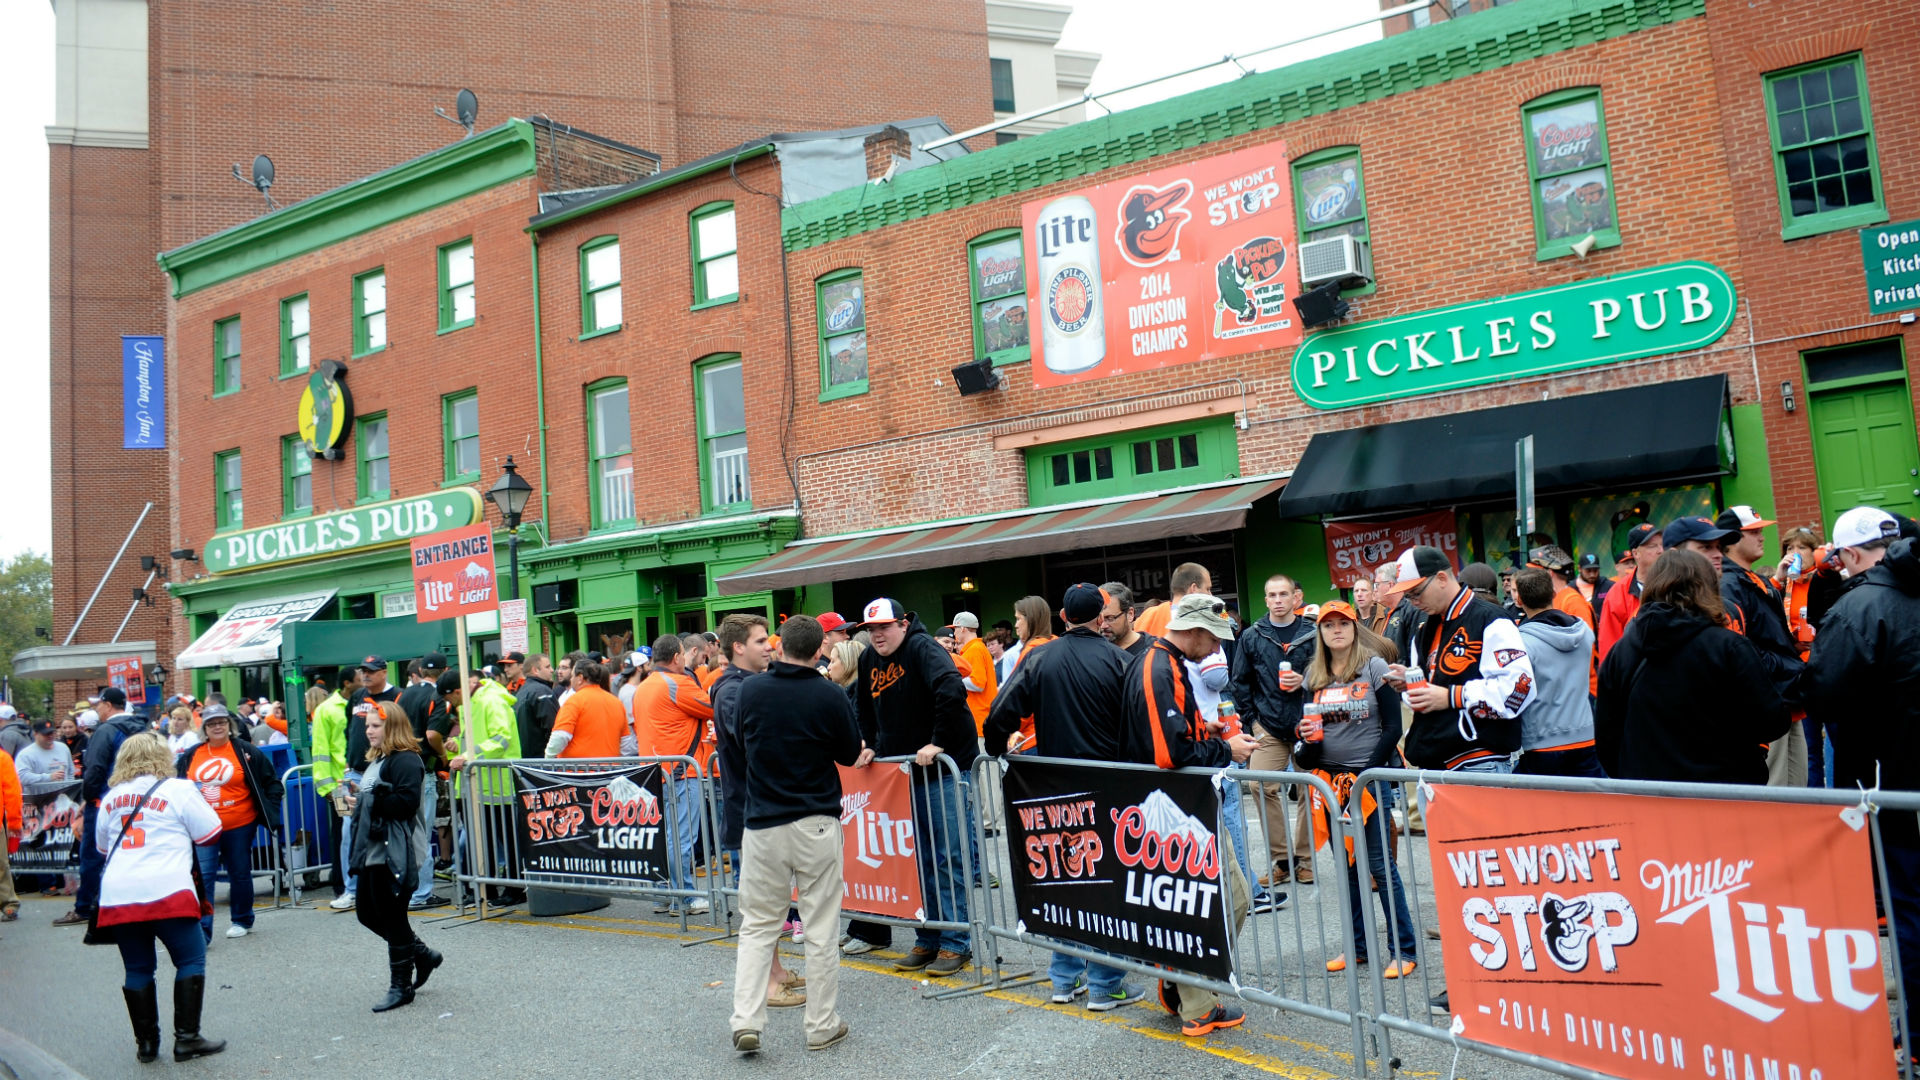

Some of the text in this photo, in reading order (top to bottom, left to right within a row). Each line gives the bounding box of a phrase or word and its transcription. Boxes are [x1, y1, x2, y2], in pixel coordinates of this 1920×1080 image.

[1540, 122, 1594, 147] Coors
[1543, 140, 1591, 160] LIGHT
[1204, 167, 1275, 202] WE WON'T
[1208, 182, 1280, 226] STOP
[1315, 191, 1344, 219] Lite
[1040, 215, 1091, 257] Lite
[1877, 229, 1919, 250] Open
[980, 256, 1019, 277] Coors
[984, 271, 1017, 288] LIGHT
[1063, 269, 1092, 303] PILSNER
[1140, 272, 1171, 299] 2014
[833, 305, 853, 329] Lite
[1058, 317, 1089, 331] BEER
[1128, 297, 1188, 329] DIVISION
[1132, 324, 1189, 357] CHAMPS
[1308, 282, 1714, 389] PICKLES PUB
[133, 341, 155, 444] Hampton Inn
[227, 499, 438, 566] PICKLES PUB
[1332, 525, 1427, 549] WE WON'T Miller
[415, 536, 489, 567] ENTRANCE
[1335, 540, 1394, 569] STOP
[422, 580, 455, 611] Lite
[459, 587, 491, 605] LIGHT
[1121, 566, 1164, 596] Lite
[229, 597, 327, 620] SPORTS RADIO
[522, 787, 579, 810] WE WON'T
[587, 787, 663, 827] Coors
[43, 801, 76, 830] Coor
[121, 811, 146, 850] 5
[527, 805, 585, 841] STOP
[1018, 799, 1096, 831] WE WON'T
[45, 827, 76, 845] LIGH
[597, 827, 660, 850] LIGHT
[841, 808, 914, 870] Lite
[1110, 805, 1220, 880] Coors
[564, 857, 607, 874] DIVISION
[611, 860, 650, 876] CHAMPS
[1025, 830, 1104, 879] STOP
[1447, 838, 1621, 888] WE WON'T
[854, 882, 898, 905] CHAMPS
[1125, 870, 1219, 919] LIGHT
[1640, 857, 1754, 912] Miller
[1043, 902, 1204, 958] 2014 DIVISION CHAMPS
[1462, 891, 1639, 974] STOP
[1656, 893, 1880, 1023] Lite
[1498, 997, 1551, 1037] 2014
[1564, 1012, 1686, 1070] DIVISION
